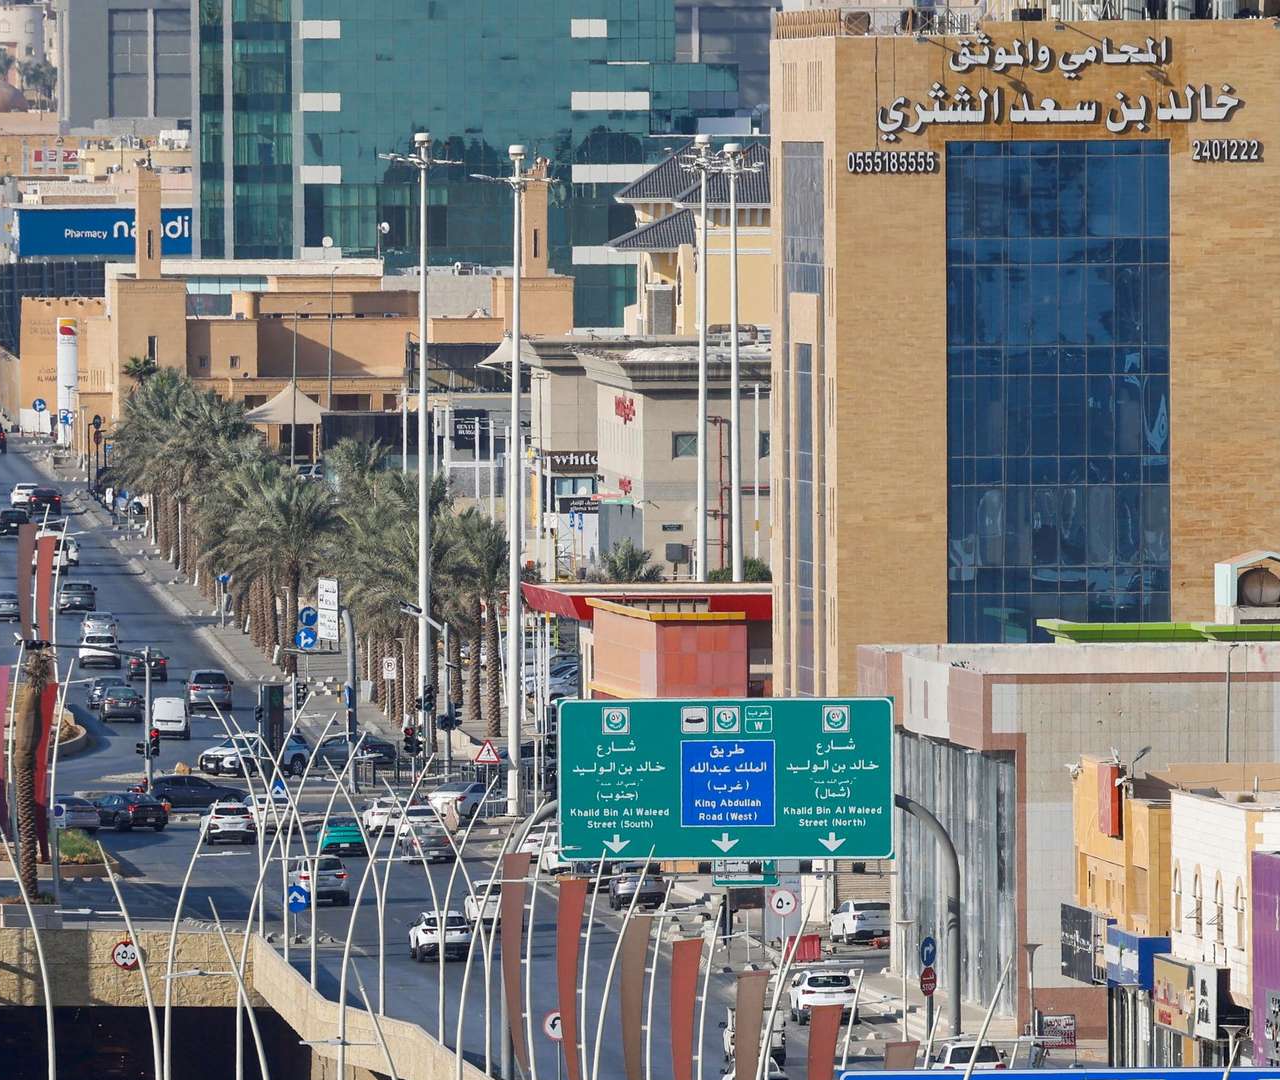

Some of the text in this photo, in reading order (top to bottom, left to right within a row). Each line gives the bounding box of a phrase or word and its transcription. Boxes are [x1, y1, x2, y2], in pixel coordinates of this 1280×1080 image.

[949, 33, 1171, 79] المحامي والموثق
[877, 80, 1241, 142] خالد بن سعد الشثري
[1192, 140, 1260, 161] 2401222
[847, 151, 936, 173] 0555185555
[64, 228, 108, 240] Pharmacy
[113, 216, 189, 239] nadi
[754, 721, 763, 730] W
[596, 739, 637, 757] شارع
[710, 743, 745, 758] طريق
[816, 738, 856, 755] شارع
[572, 761, 666, 775] خالد بن الوليد
[689, 762, 767, 773] الملك عبدالله
[786, 760, 880, 774] خالد بن الوليد
[596, 790, 639, 802] (جنوب)
[815, 786, 851, 799] (شمال)
[695, 799, 761, 808] King Abdullah
[570, 808, 670, 817] Khalid Bin Al Waleed
[699, 812, 757, 822] Road (West)
[783, 807, 882, 815] Khalid Bin Al Waleed
[587, 820, 654, 829] Street (South)
[799, 818, 866, 827] Street (North)
